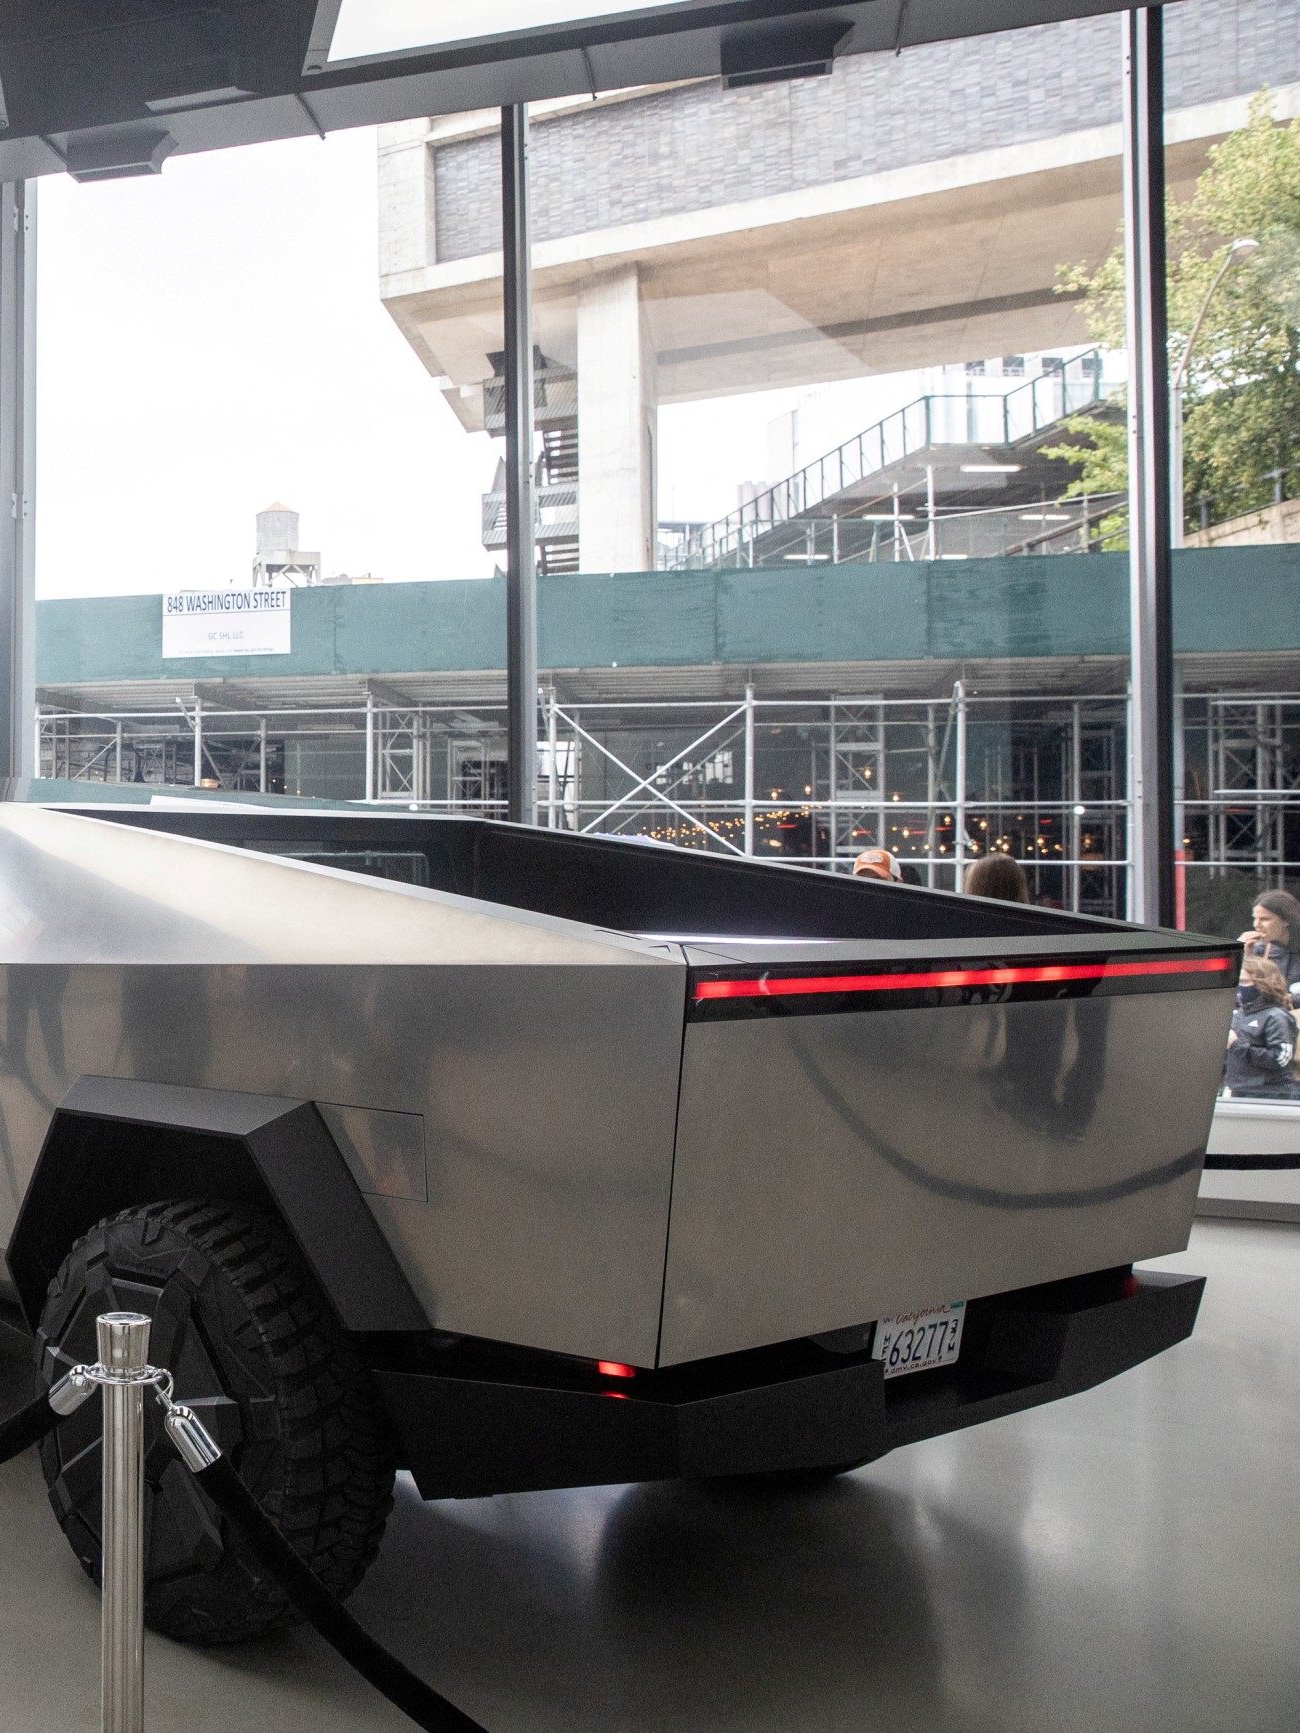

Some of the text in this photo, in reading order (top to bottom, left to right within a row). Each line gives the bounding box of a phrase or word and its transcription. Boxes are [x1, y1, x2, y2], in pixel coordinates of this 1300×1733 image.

[167, 591, 287, 613] 848 WASHINGTON STREET
[890, 1321, 949, 1366] 63277
[891, 1358, 937, 1374] dmv.ca.gov
